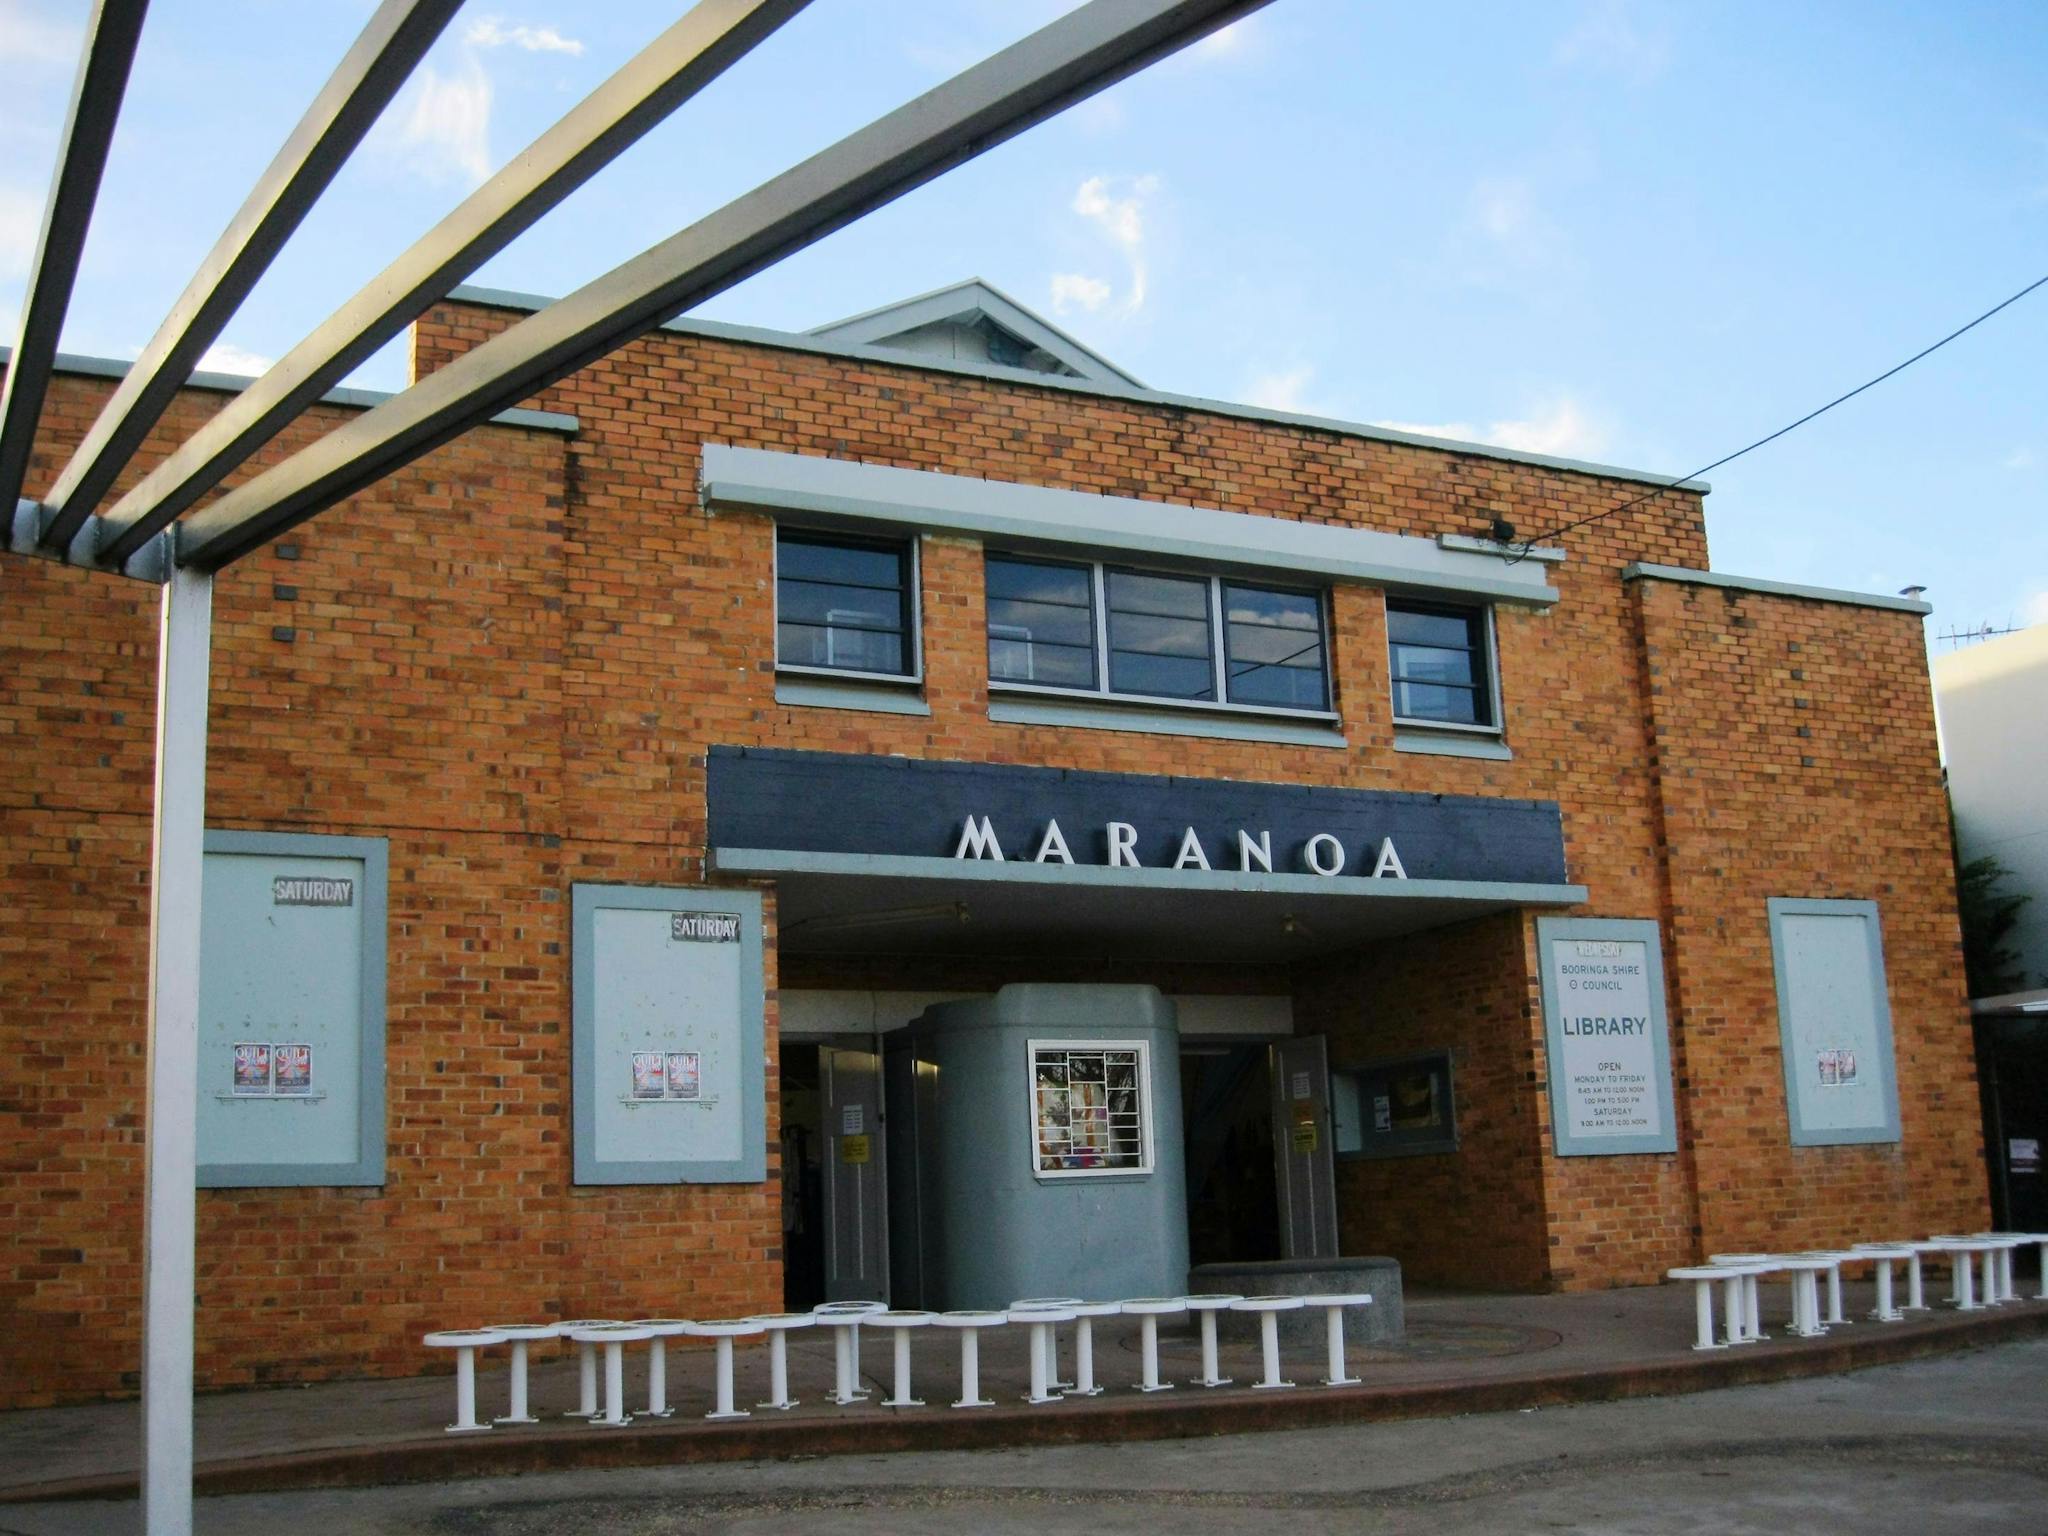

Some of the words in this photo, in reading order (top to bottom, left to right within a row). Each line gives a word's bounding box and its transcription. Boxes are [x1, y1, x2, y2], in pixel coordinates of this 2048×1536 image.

[955, 814, 1408, 880] MARANOA
[276, 880, 350, 901] SATURDAY
[673, 918, 737, 937] SATURDAY
[1561, 965, 1609, 975] BOORINGA
[1612, 965, 1640, 976] SHIRE
[1582, 980, 1622, 990] COUNCIL
[1563, 1017, 1646, 1035] LIBRARY
[235, 1047, 269, 1061] QUILT
[275, 1047, 310, 1061] QUILT
[633, 1055, 662, 1067] QUILT
[669, 1056, 698, 1067] QUILT
[1598, 1062, 1621, 1071] OPEN
[1574, 1075, 1605, 1083] MONDAY
[1608, 1075, 1617, 1083] TO
[1593, 1108, 1632, 1116] SATURDAY
